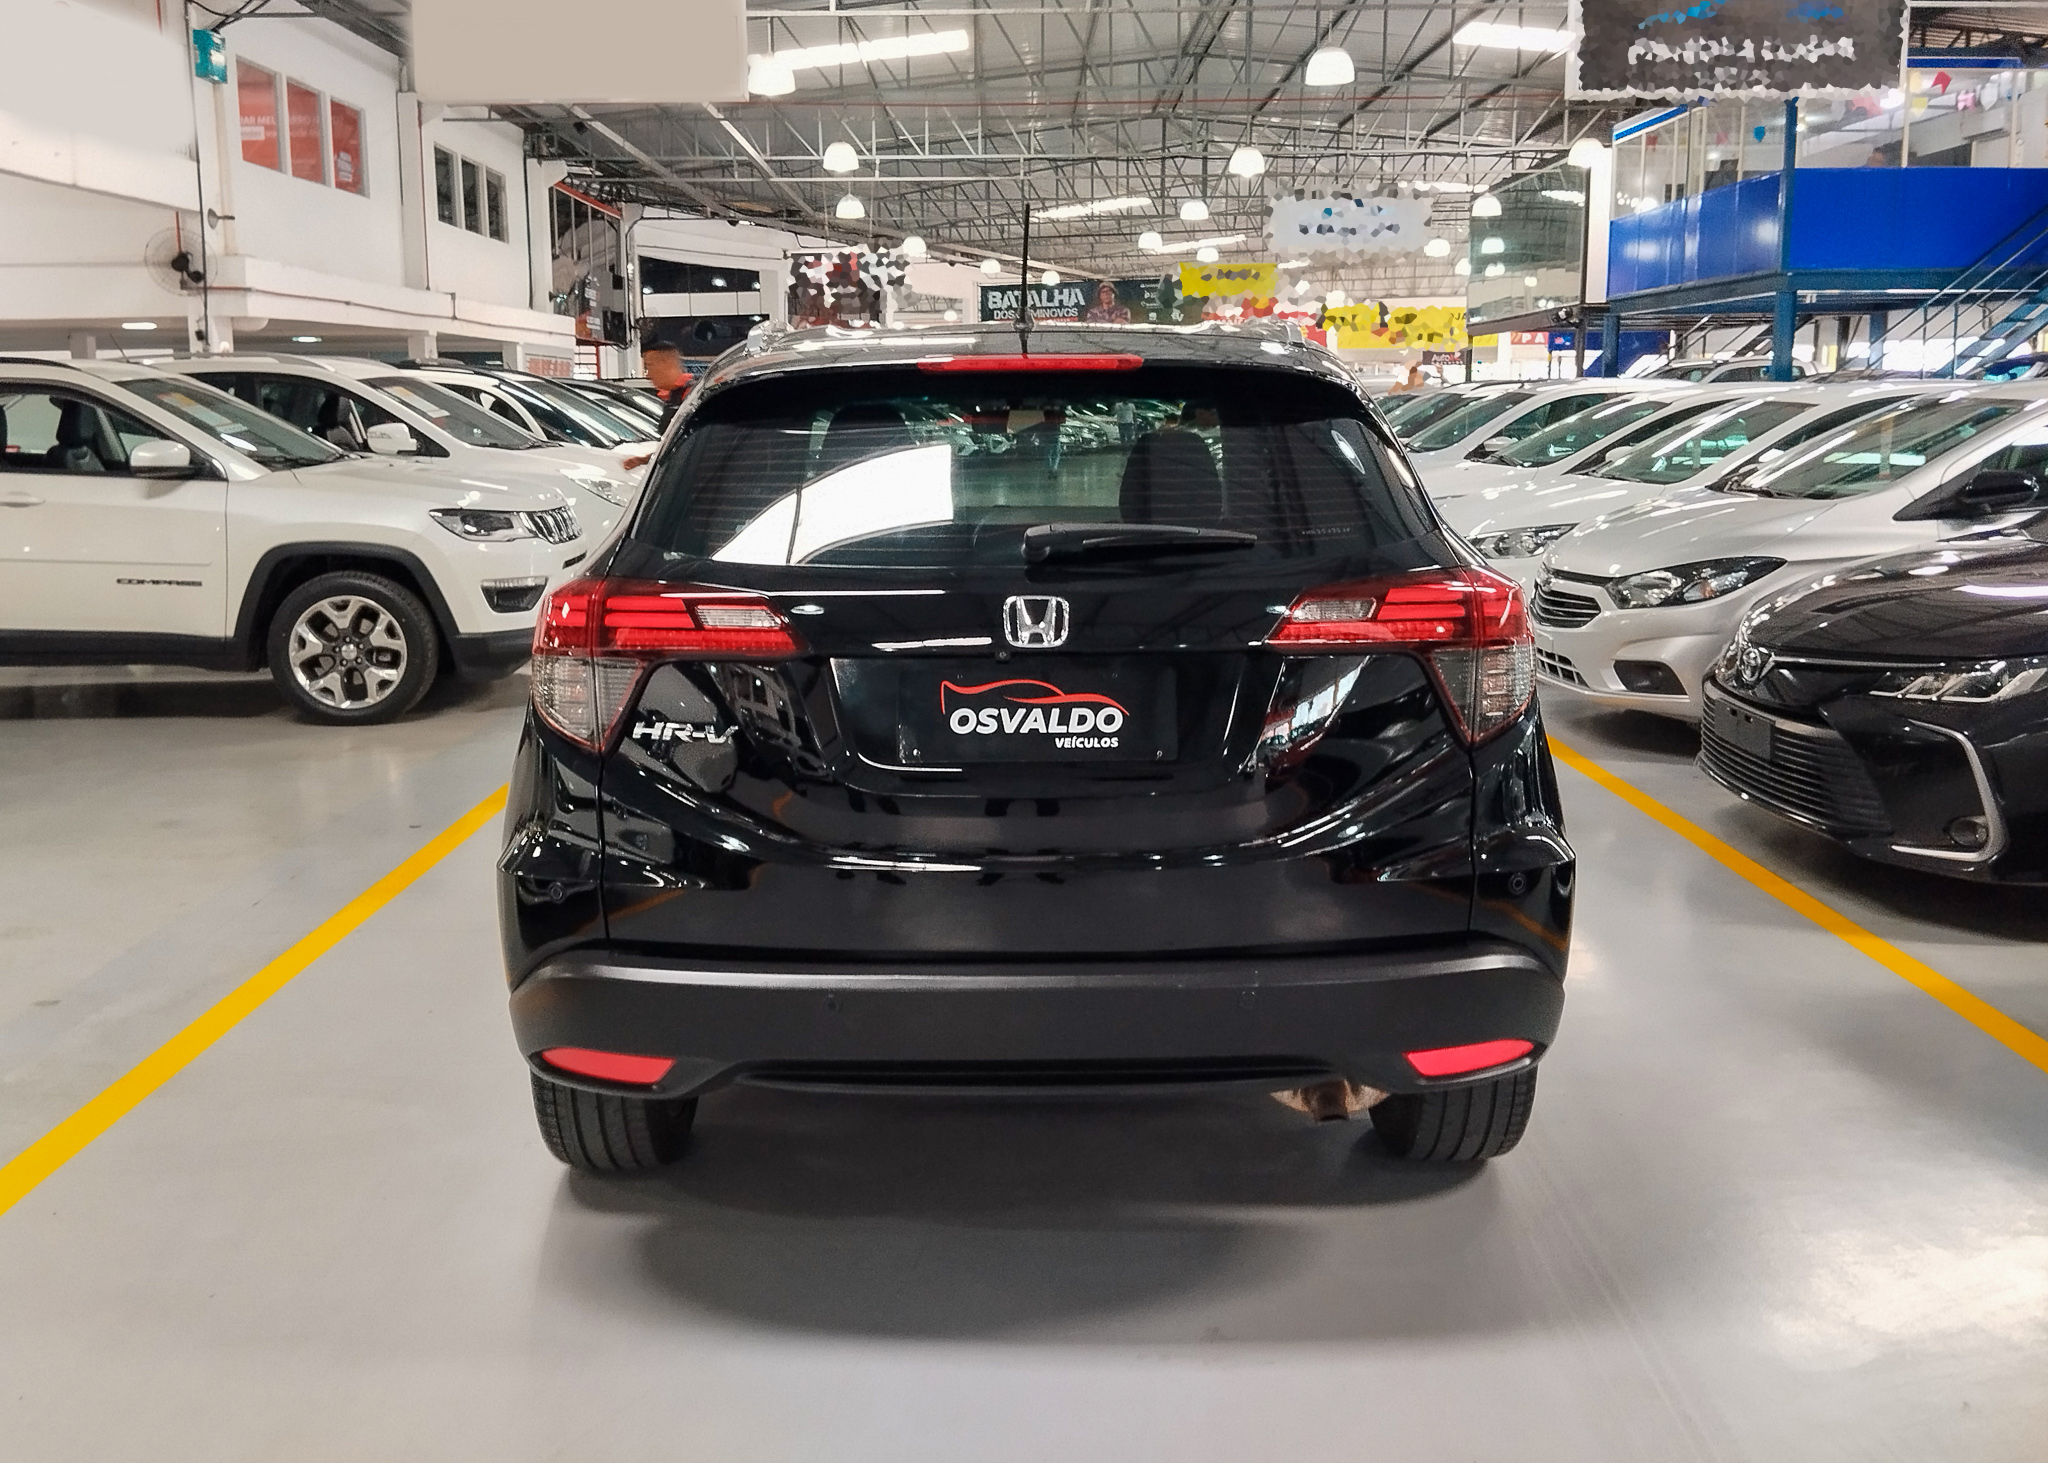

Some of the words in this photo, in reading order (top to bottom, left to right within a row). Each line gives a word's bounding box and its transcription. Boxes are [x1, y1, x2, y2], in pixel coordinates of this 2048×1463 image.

[994, 309, 1015, 319] DOS
[949, 706, 1124, 735] OSVALDO
[632, 721, 739, 744] HR-V
[1055, 735, 1119, 749] VEÍCULOS
